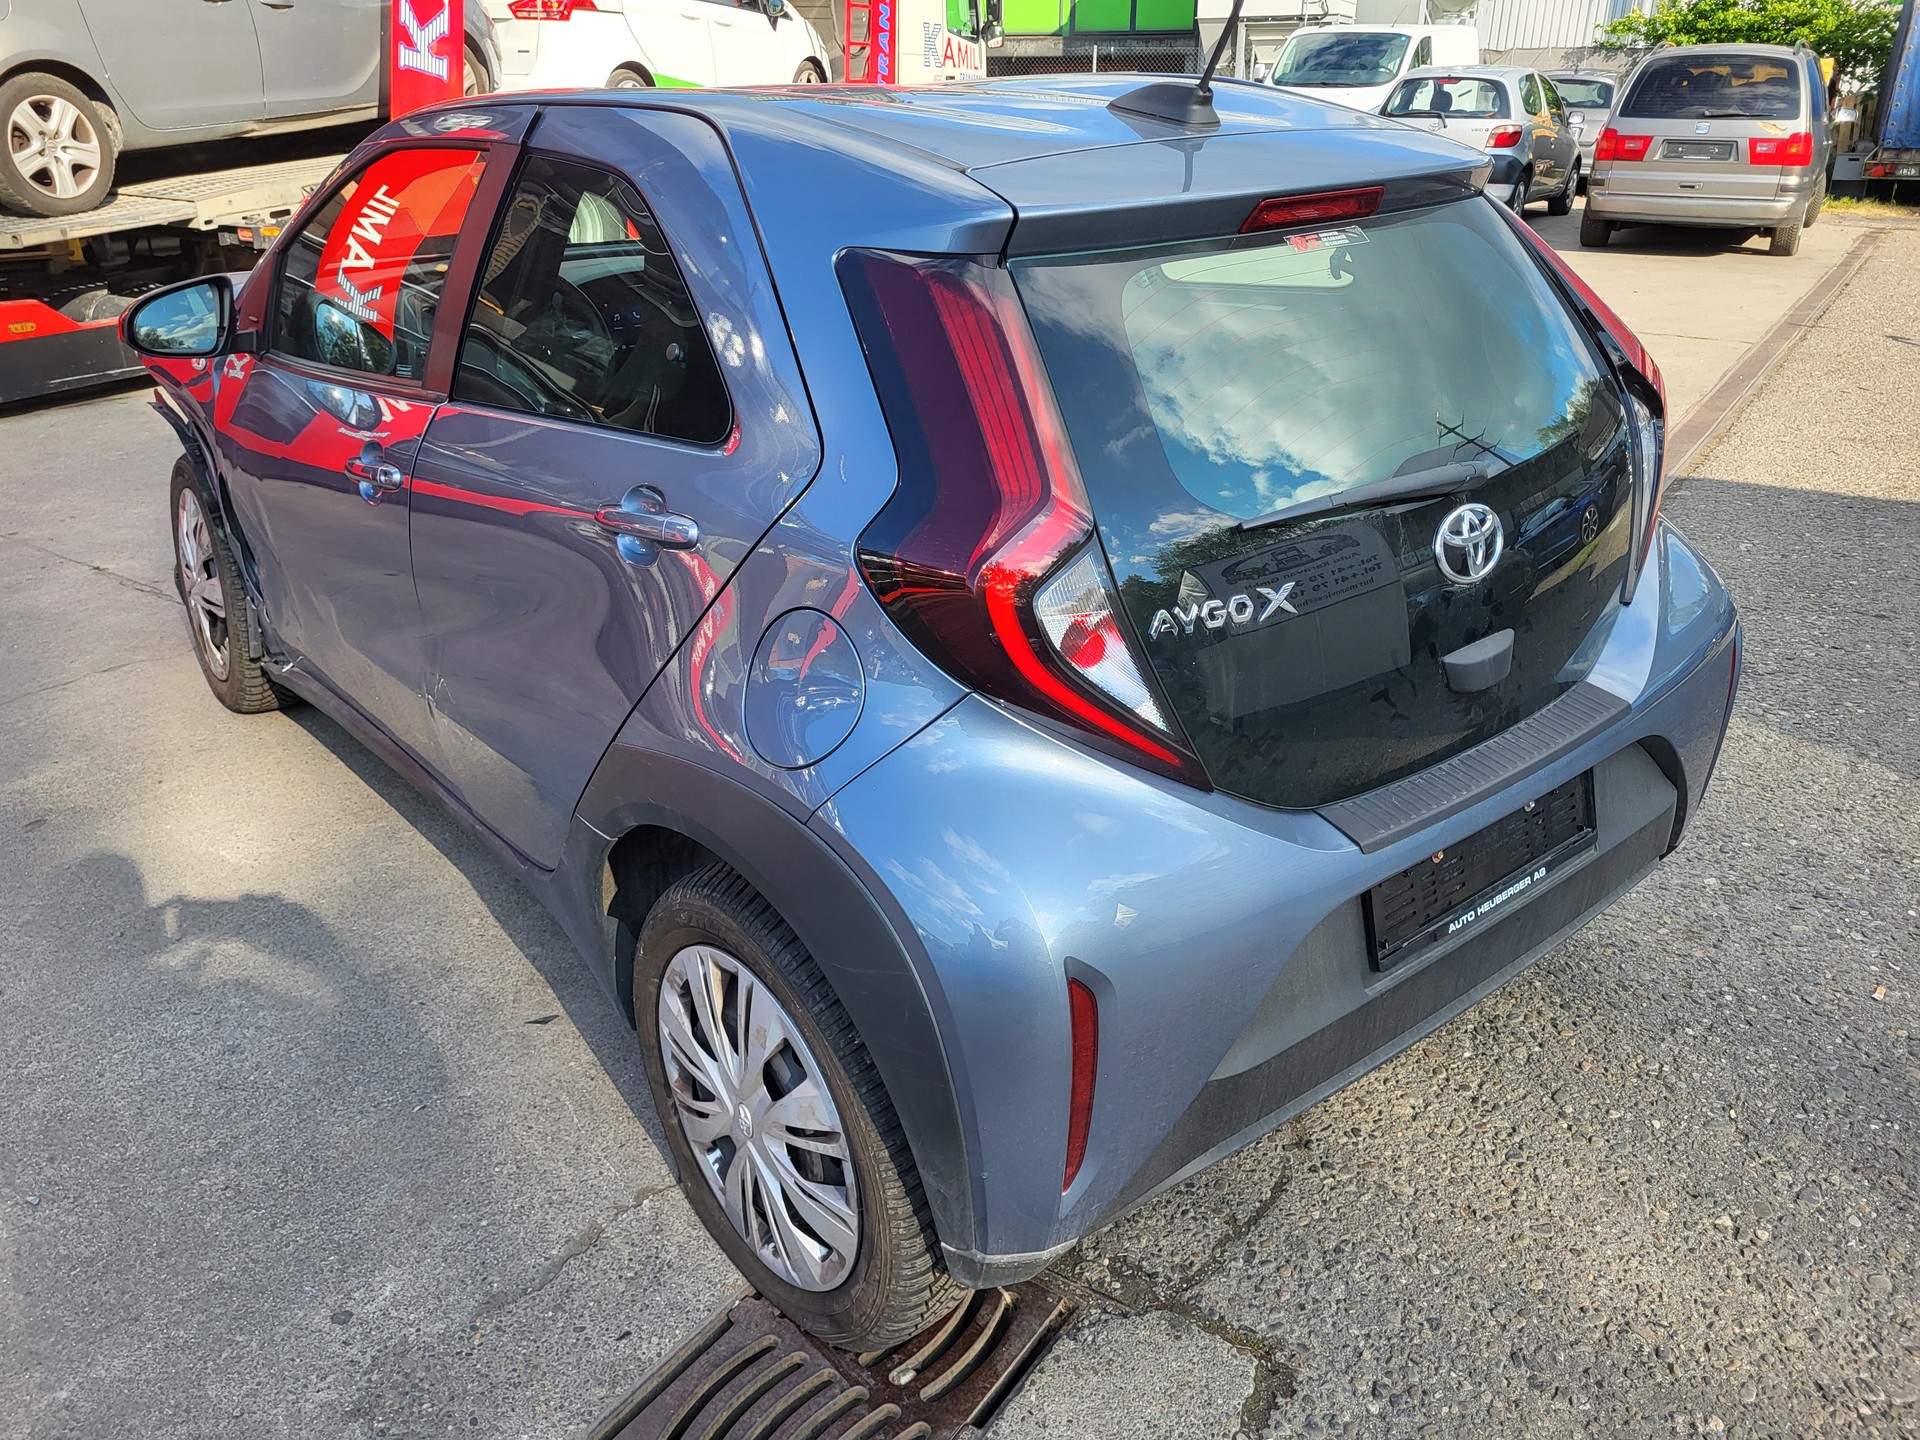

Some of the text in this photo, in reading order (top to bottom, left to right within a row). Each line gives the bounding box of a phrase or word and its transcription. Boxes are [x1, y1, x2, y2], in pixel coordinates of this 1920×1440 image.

[877, 0, 891, 84] TRAN
[1148, 582, 1298, 640] AYGO X
[1448, 867, 1546, 934] AUTO HEUBERGER AG
